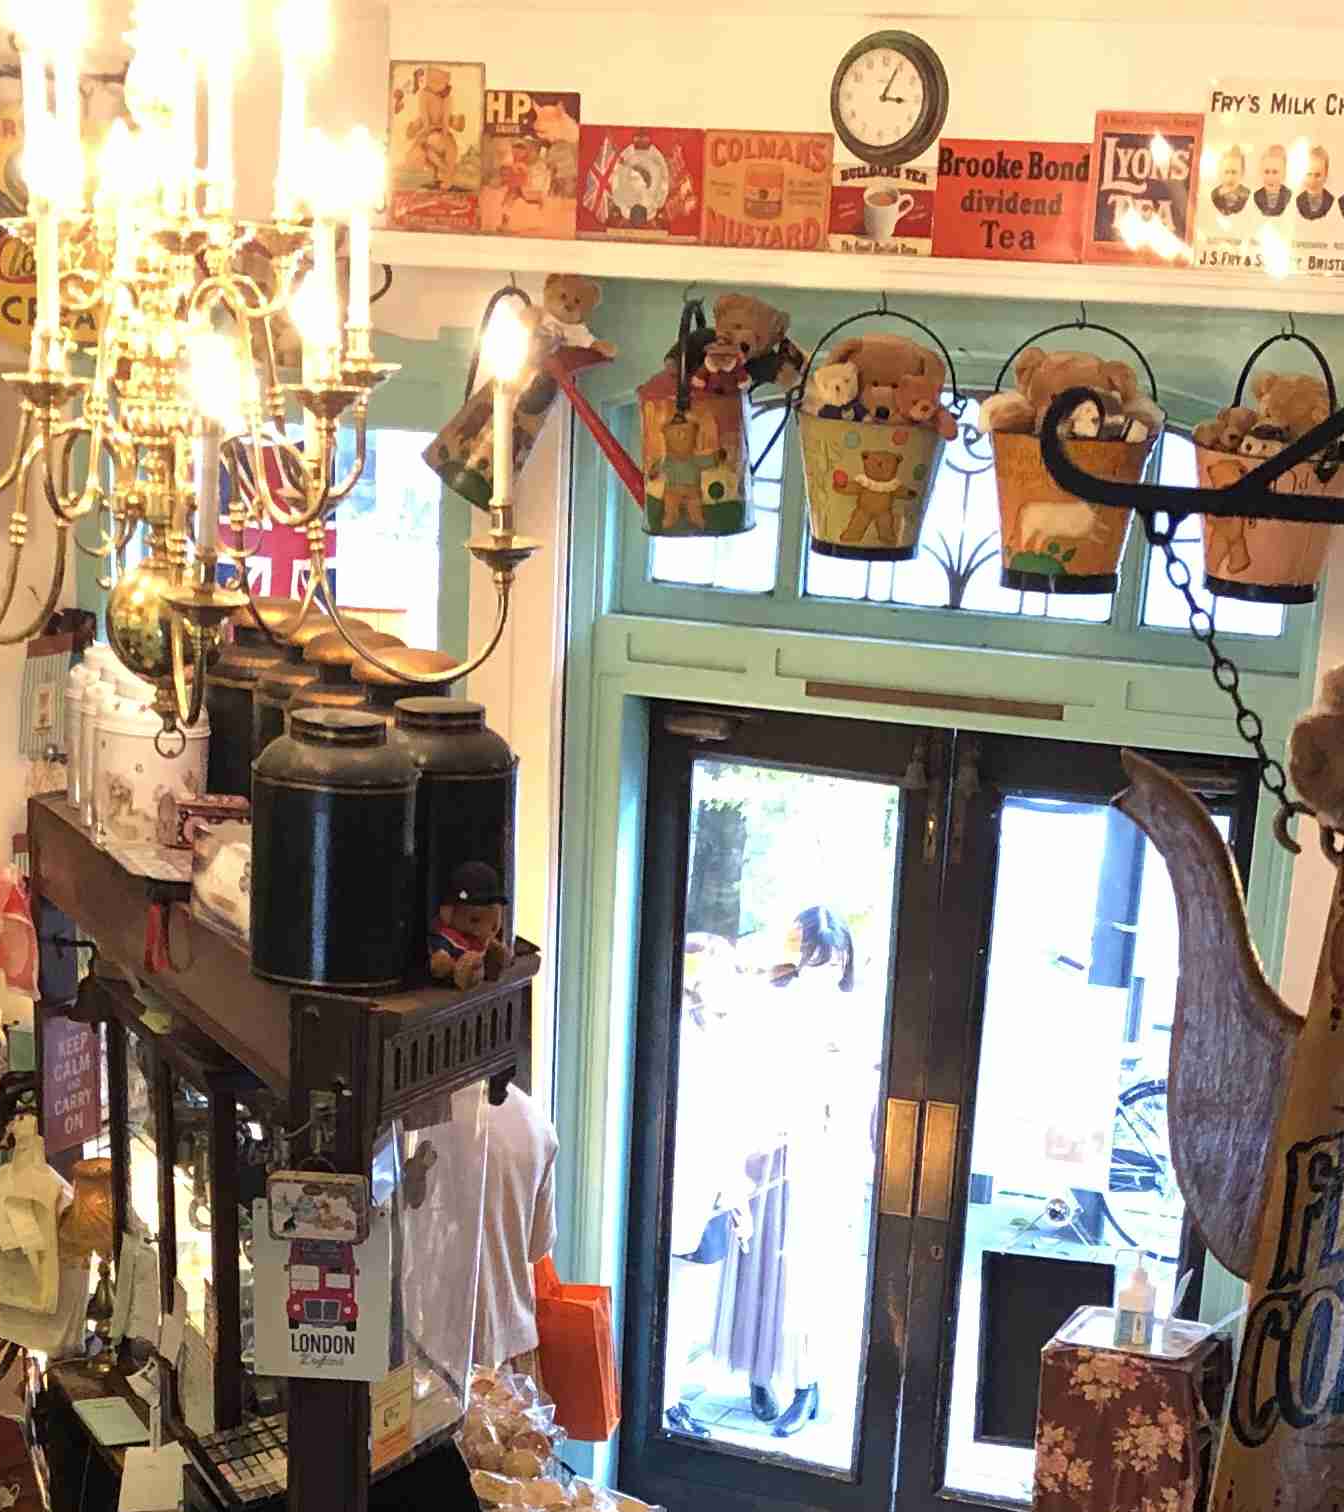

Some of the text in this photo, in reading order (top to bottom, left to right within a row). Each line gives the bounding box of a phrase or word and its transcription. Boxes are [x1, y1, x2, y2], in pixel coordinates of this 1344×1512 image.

[1211, 91, 1261, 114] FRY'S
[1270, 93, 1316, 116] MILK
[711, 137, 828, 174] COLMAN'S
[937, 145, 1091, 183] Brooke Bond
[906, 167, 929, 186] TEA
[960, 188, 1064, 216] dividend
[706, 205, 822, 250] MUSTARD
[979, 219, 1036, 251] Tea
[56, 1030, 89, 1058] KEEP
[54, 1053, 91, 1082] CALM
[54, 1087, 92, 1116] CARRY
[64, 1110, 84, 1135] ON
[290, 1333, 355, 1355] LONDON
